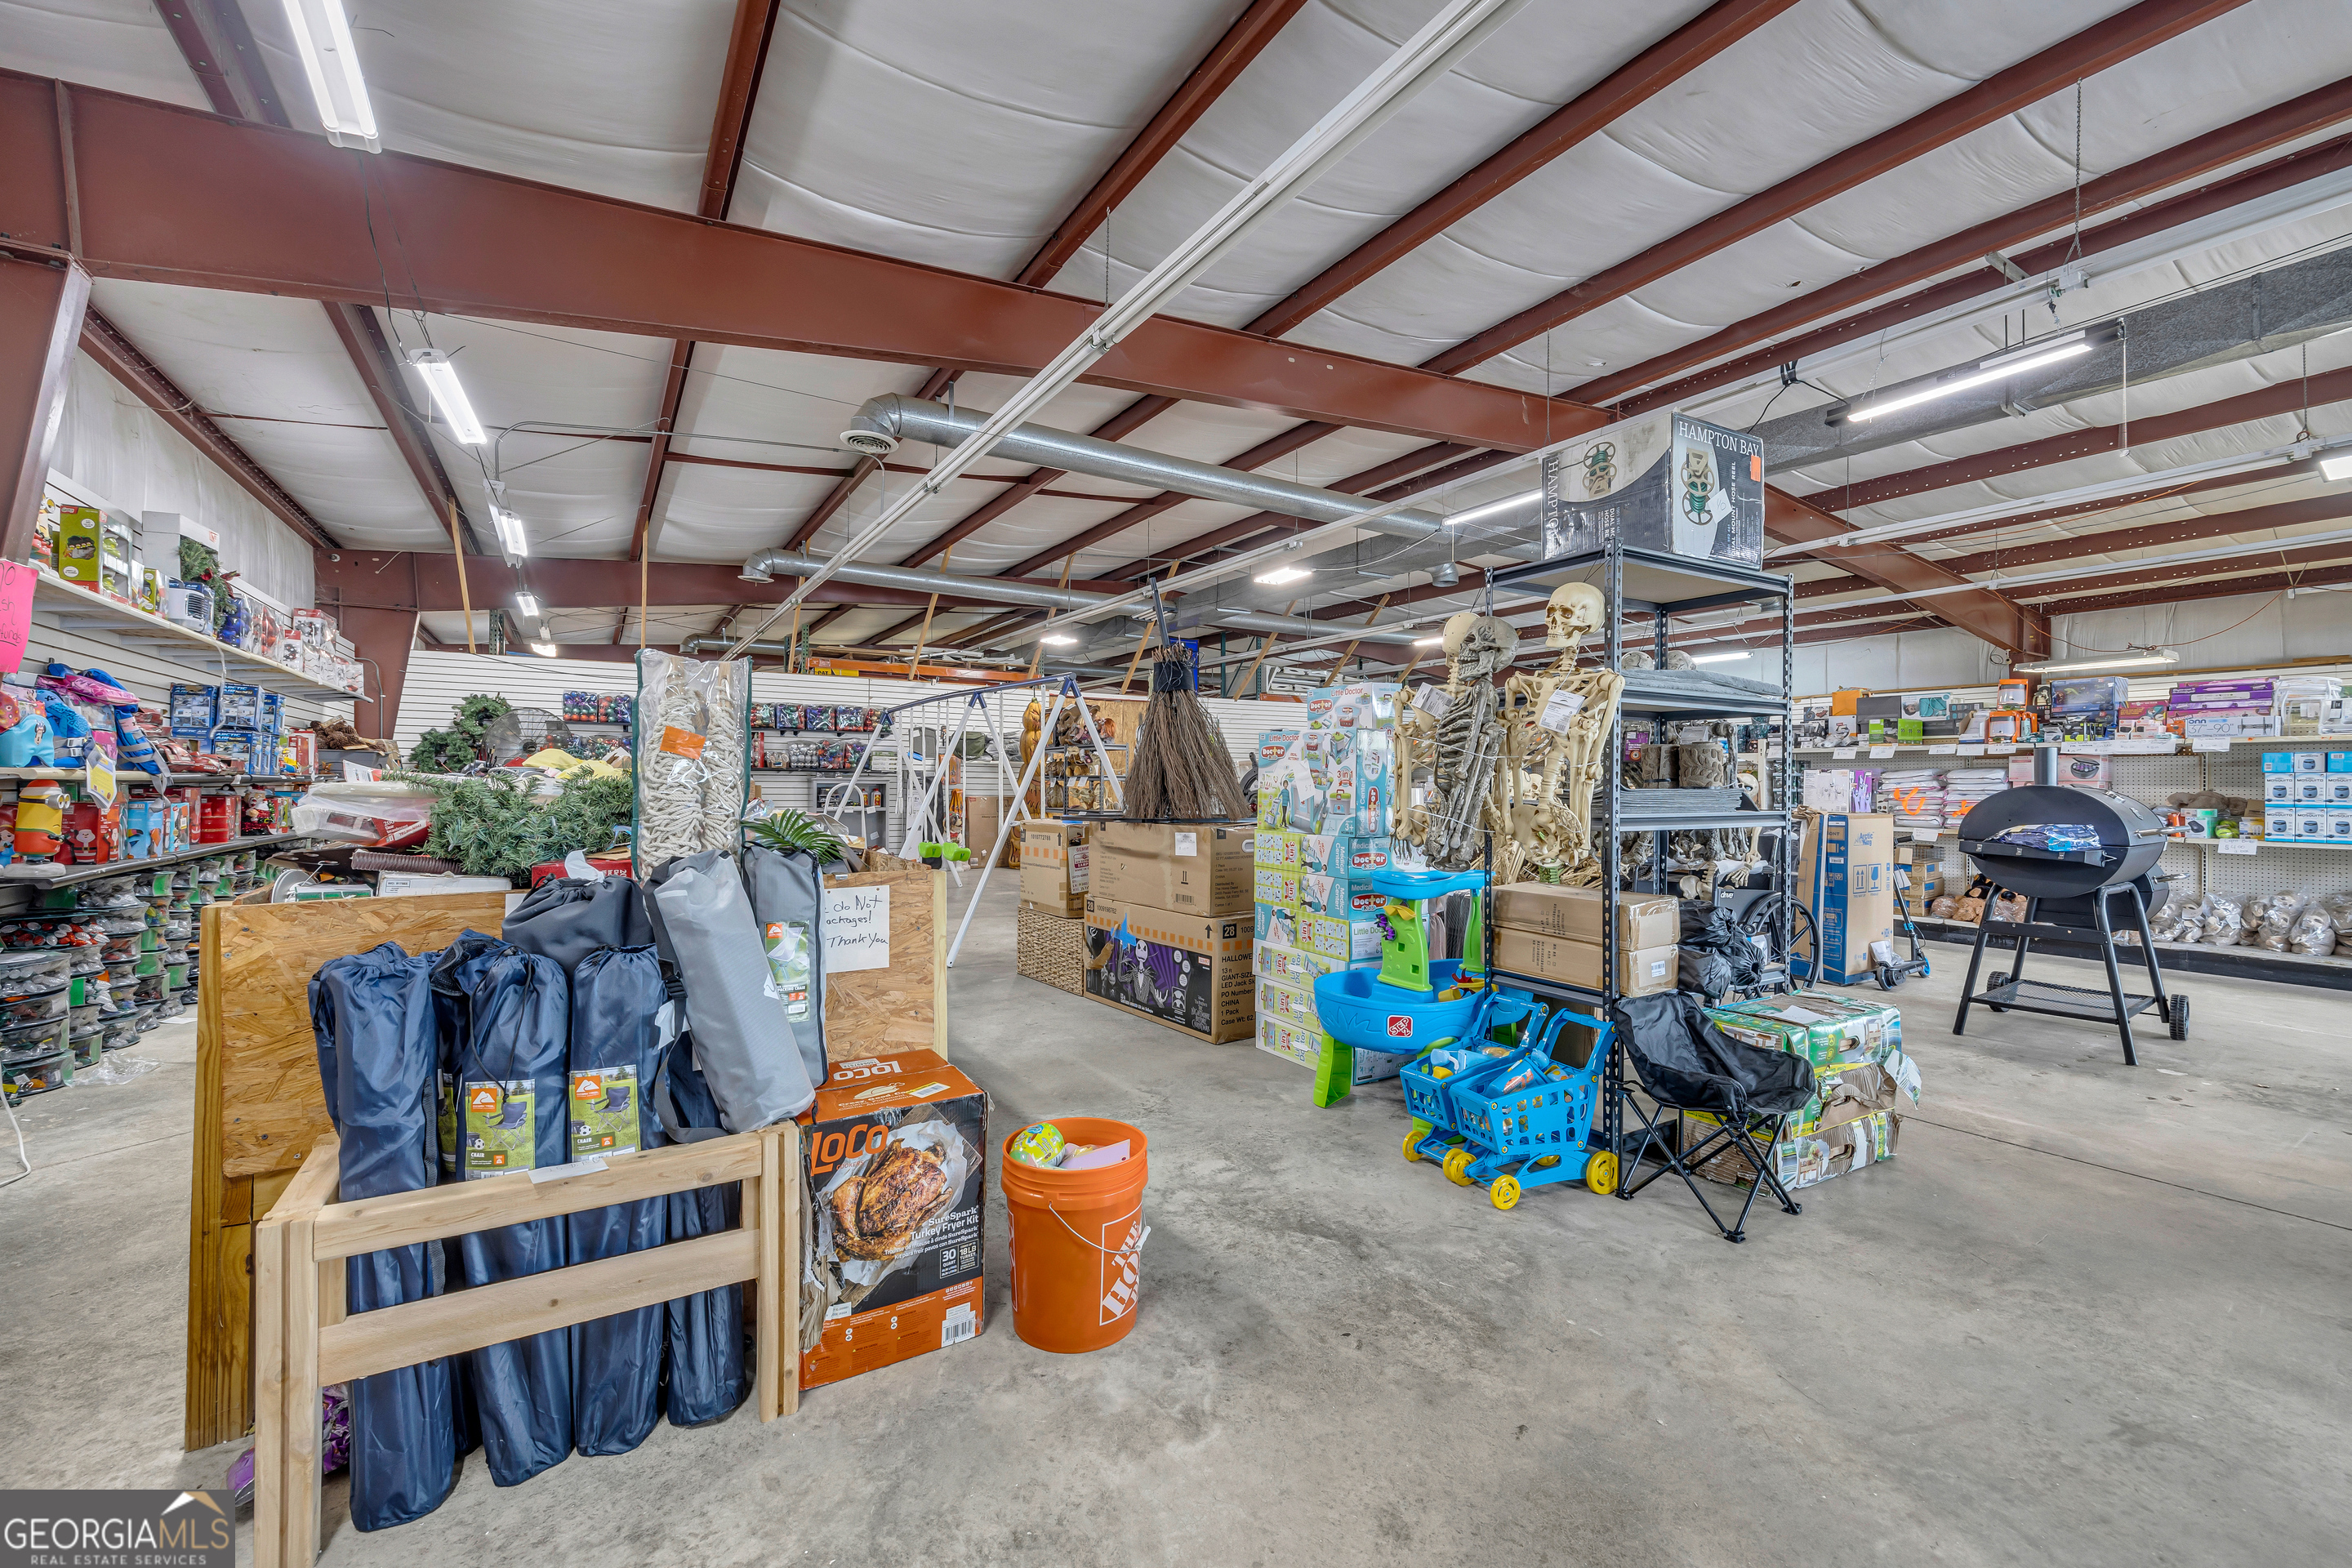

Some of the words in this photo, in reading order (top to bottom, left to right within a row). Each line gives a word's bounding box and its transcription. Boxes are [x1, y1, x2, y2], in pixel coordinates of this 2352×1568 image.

[1678, 421, 1738, 452] HAMPTON
[1740, 439, 1760, 458] BAY
[0, 597, 16, 625] sh
[1, 623, 22, 644] funds
[1330, 689, 1343, 697] Little
[1345, 688, 1363, 696] Doctor
[1282, 733, 1299, 742] Doctor
[1337, 770, 1341, 778] 3
[1342, 770, 1348, 778] in
[1350, 770, 1353, 778] 1
[833, 902, 851, 912] do
[855, 894, 883, 911] Not
[1087, 902, 1094, 911] 28
[826, 910, 872, 927] ackages!
[1224, 926, 1236, 937] 28
[1241, 925, 1254, 933] 1009
[1370, 926, 1384, 934] Doc
[826, 933, 867, 948] Thank
[867, 933, 889, 948] You
[1222, 953, 1252, 963] HALLOWE
[1222, 971, 1254, 981] GIANT-SIZE
[1231, 989, 1254, 997] Number:
[1221, 999, 1240, 1007] CHINA
[1225, 1008, 1240, 1016] Pack
[1221, 1018, 1236, 1026] Case
[1390, 1017, 1410, 1036] STEP
[1401, 1027, 1410, 1036] 2
[833, 1060, 902, 1080] LOCO
[810, 1124, 889, 1176] LOCO
[836, 1160, 864, 1170] COOKERS
[911, 1225, 941, 1240] Turkey
[942, 1219, 965, 1232] Fryer
[966, 1214, 978, 1225] Kit
[934, 1233, 947, 1242] dinde
[1111, 1220, 1140, 1267] THE
[924, 1244, 938, 1254] pavos
[942, 1249, 956, 1263] 30
[960, 1252, 976, 1260] TURKEY
[942, 1259, 956, 1267] QUART
[1101, 1253, 1140, 1316] HO
